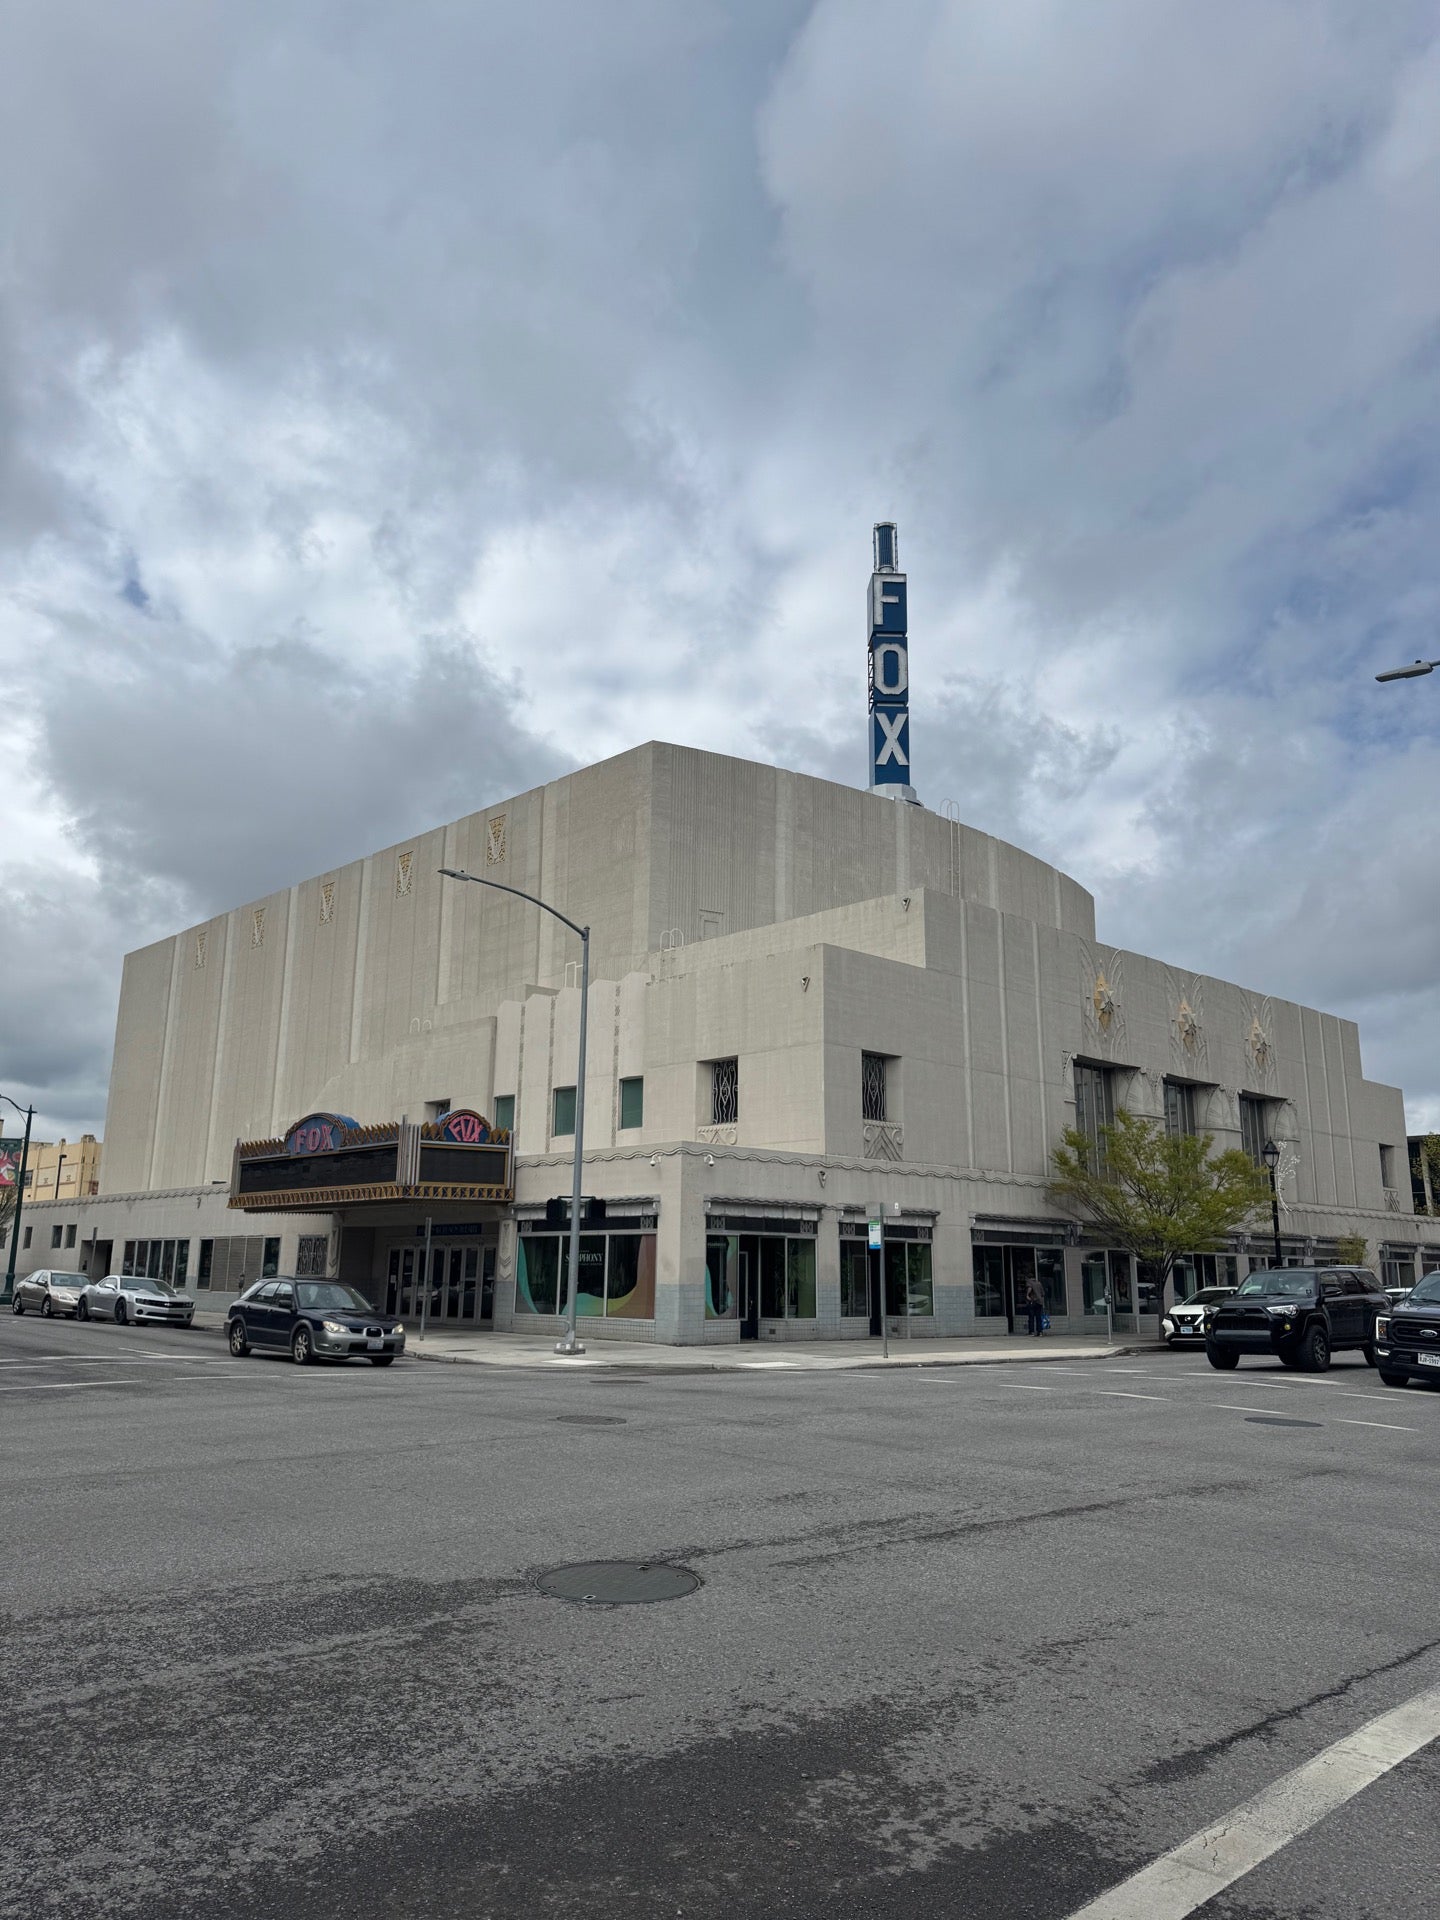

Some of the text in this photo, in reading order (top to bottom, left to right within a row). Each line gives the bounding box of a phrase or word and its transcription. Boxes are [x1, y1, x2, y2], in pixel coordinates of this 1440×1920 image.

[873, 573, 910, 766] FOX
[294, 1124, 334, 1152] FOX
[449, 1115, 484, 1142] FOX
[564, 1253, 604, 1262] SPHONY
